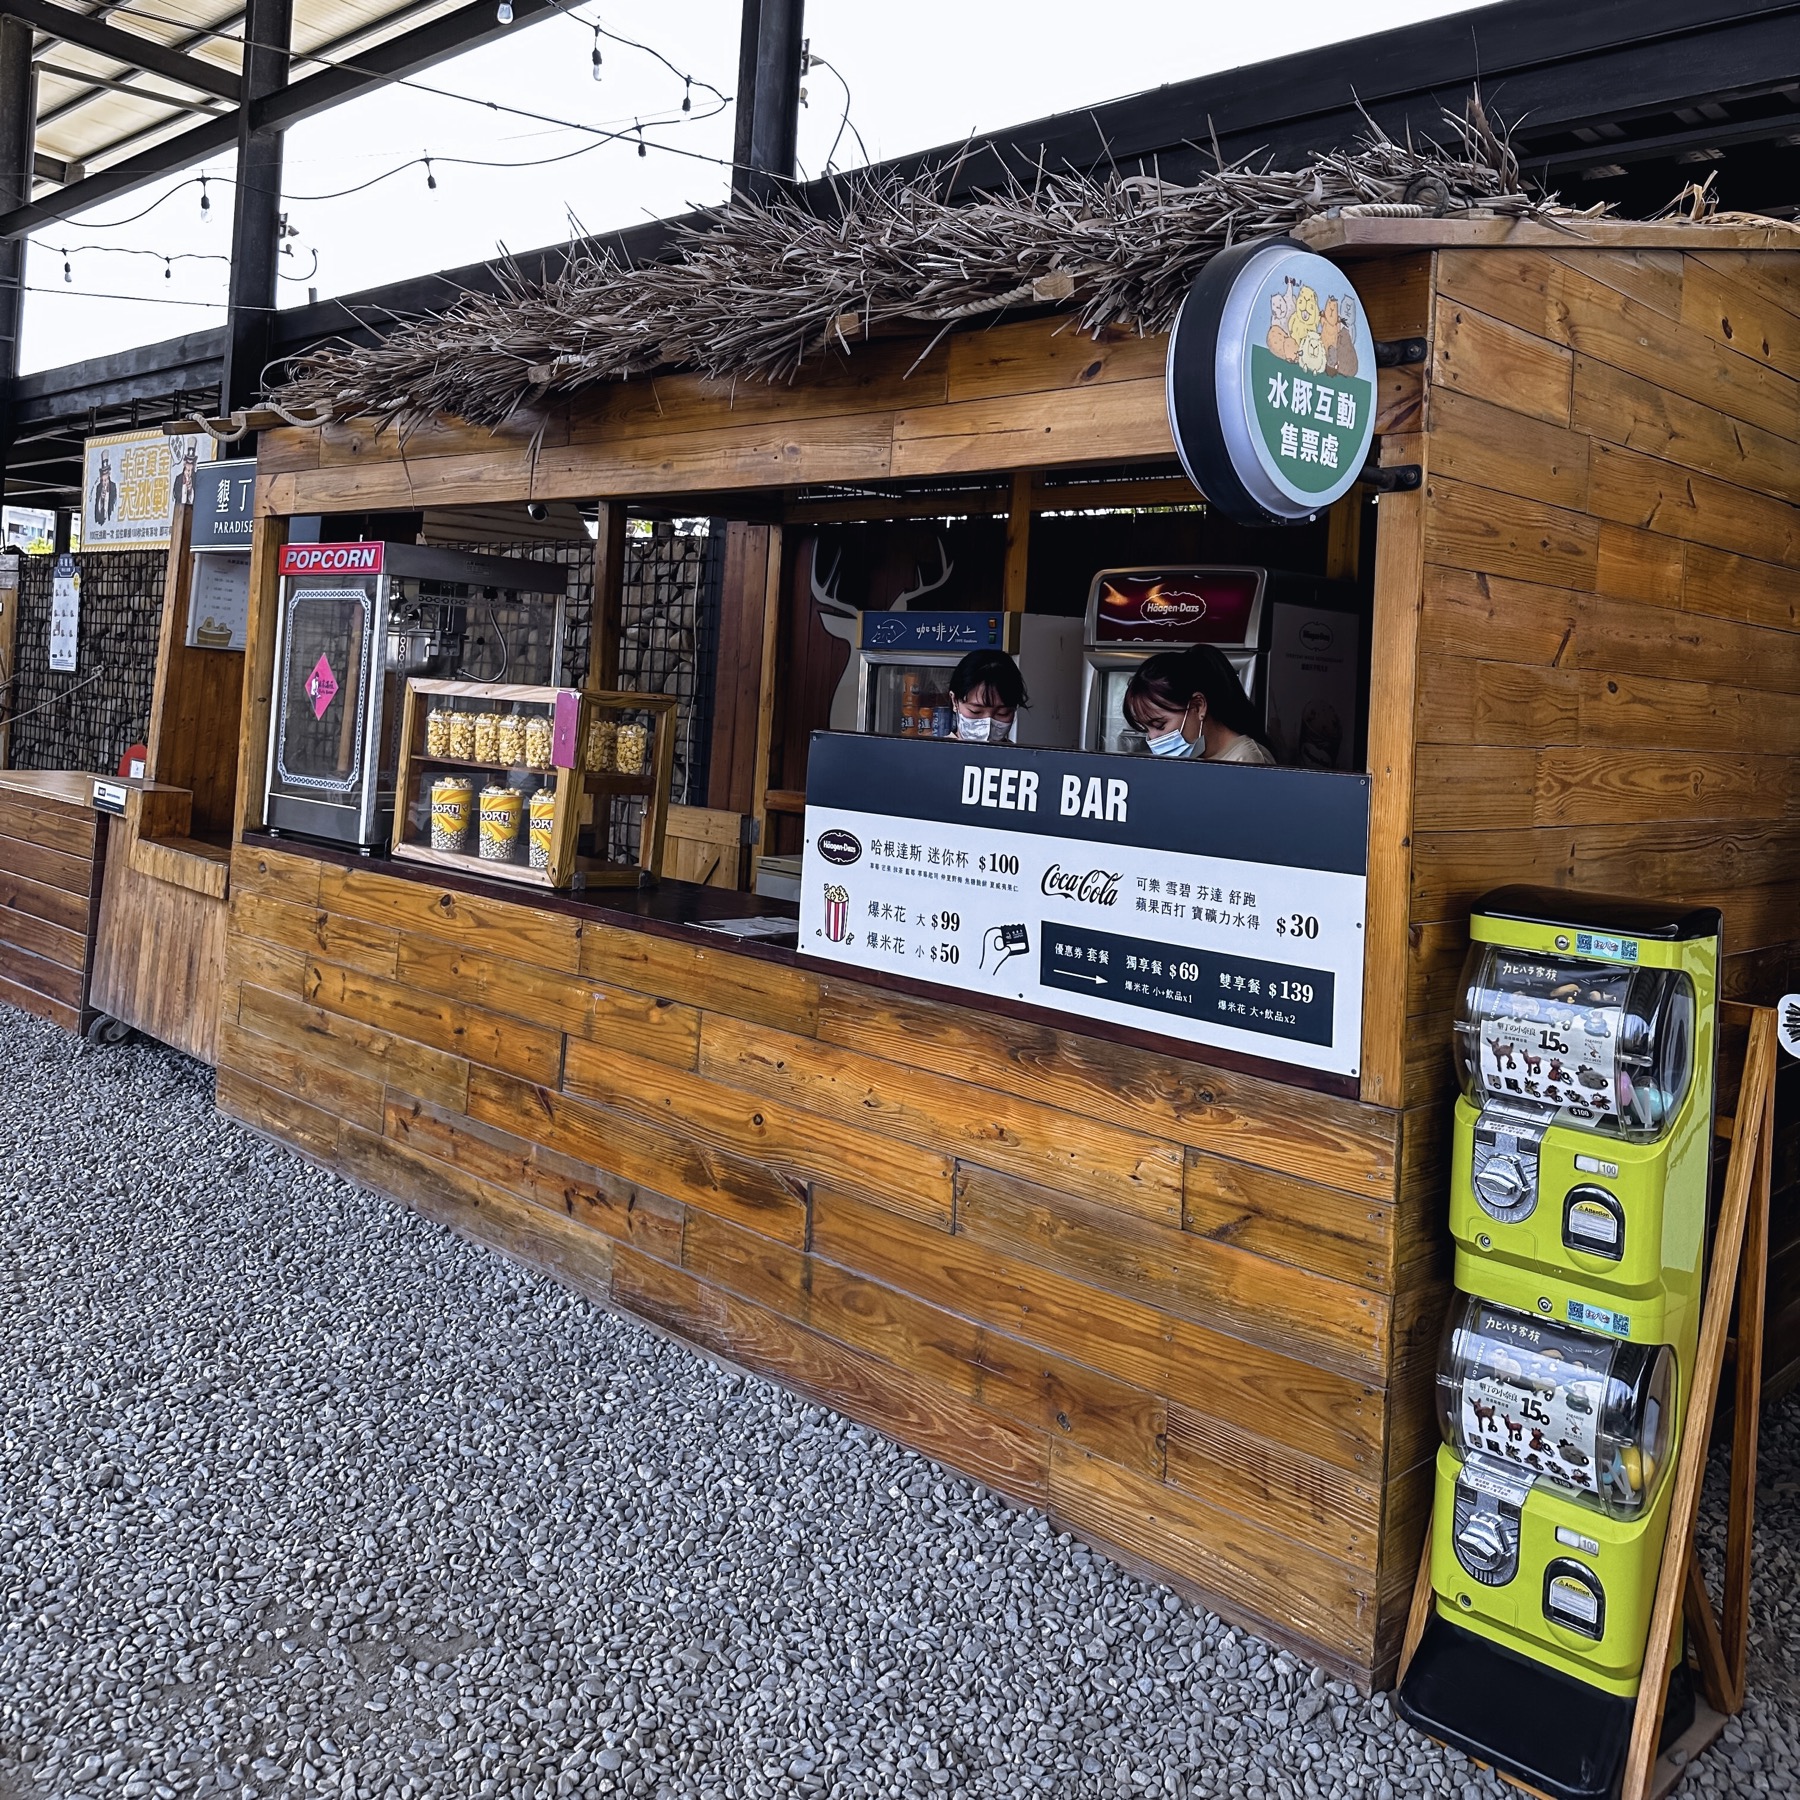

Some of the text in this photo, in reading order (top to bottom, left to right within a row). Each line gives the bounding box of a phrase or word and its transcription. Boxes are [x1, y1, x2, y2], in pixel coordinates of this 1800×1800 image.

[1267, 371, 1357, 430] 水豚互動
[1280, 421, 1339, 469] 售票處
[284, 548, 376, 569] POPCORN
[916, 622, 976, 642] 咖啡以上
[961, 765, 1129, 823] DEER BAR
[870, 838, 1020, 876] 哈根達斯 迷你杯 $100
[1136, 876, 1257, 908] 可樂 雪碧 芬達 舒跑
[867, 900, 960, 932] 爆米花 大 $99
[1135, 897, 1261, 931] 蘋果西打 寶礦力水得
[1276, 913, 1319, 940] $30
[866, 931, 960, 965] 爆米花 小 $50
[1086, 947, 1110, 966] 套餐
[1125, 954, 1200, 982] 獨享餐 $69
[1124, 980, 1150, 995] 爆米花
[1219, 972, 1314, 1004] 雙享餐 $139
[1217, 999, 1247, 1015] 爆米花
[1602, 1164, 1617, 1175] 100
[1584, 1206, 1610, 1218] Attention
[1582, 1539, 1597, 1552] 100
[1564, 1581, 1590, 1596] Attention
